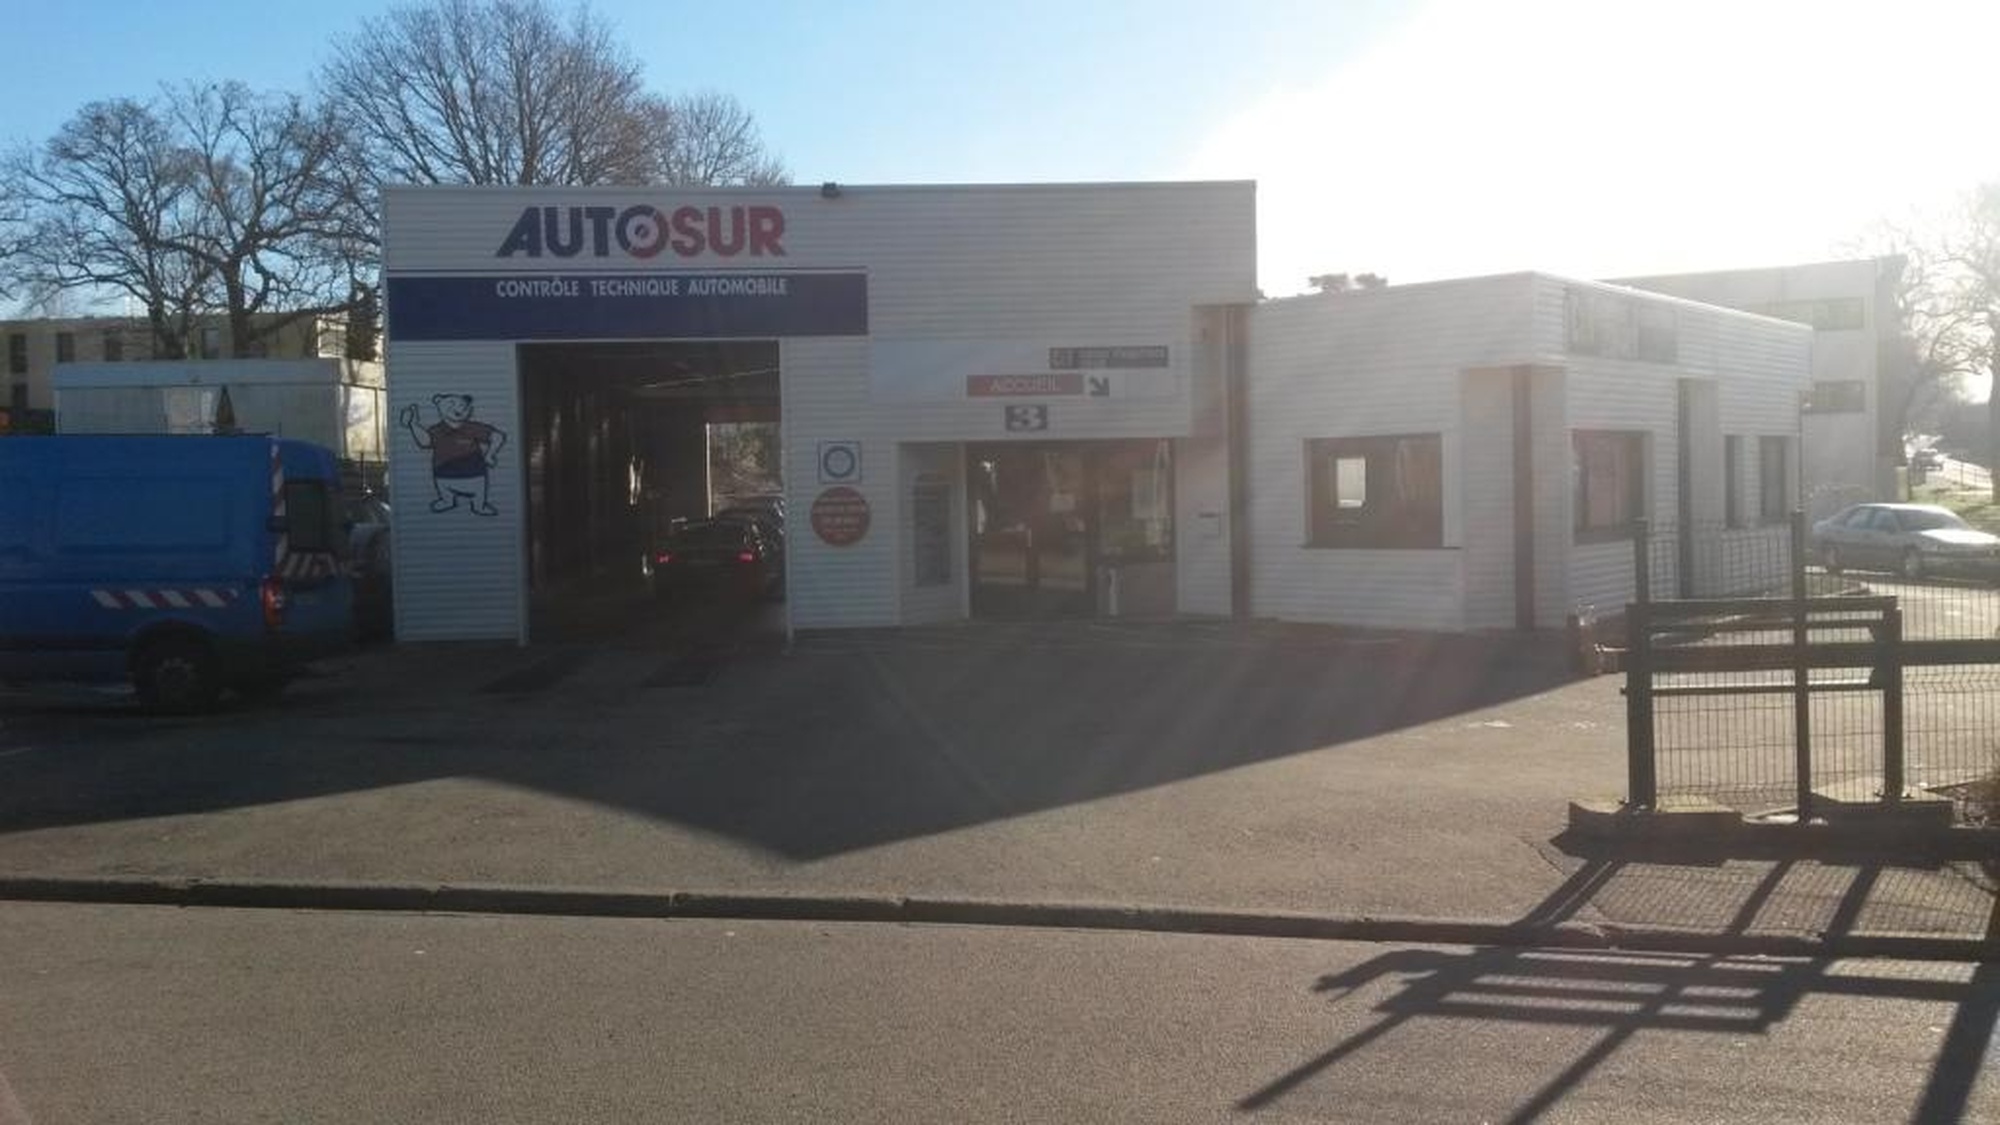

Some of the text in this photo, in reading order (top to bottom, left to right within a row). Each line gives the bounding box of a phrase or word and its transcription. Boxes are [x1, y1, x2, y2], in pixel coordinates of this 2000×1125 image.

[496, 205, 786, 259] AUTOSUR
[496, 277, 787, 298] CONTRÔLE TECHNIQUE AUTOMOBILE
[989, 376, 1061, 392] ACCUEIL
[1010, 406, 1043, 430] 3
